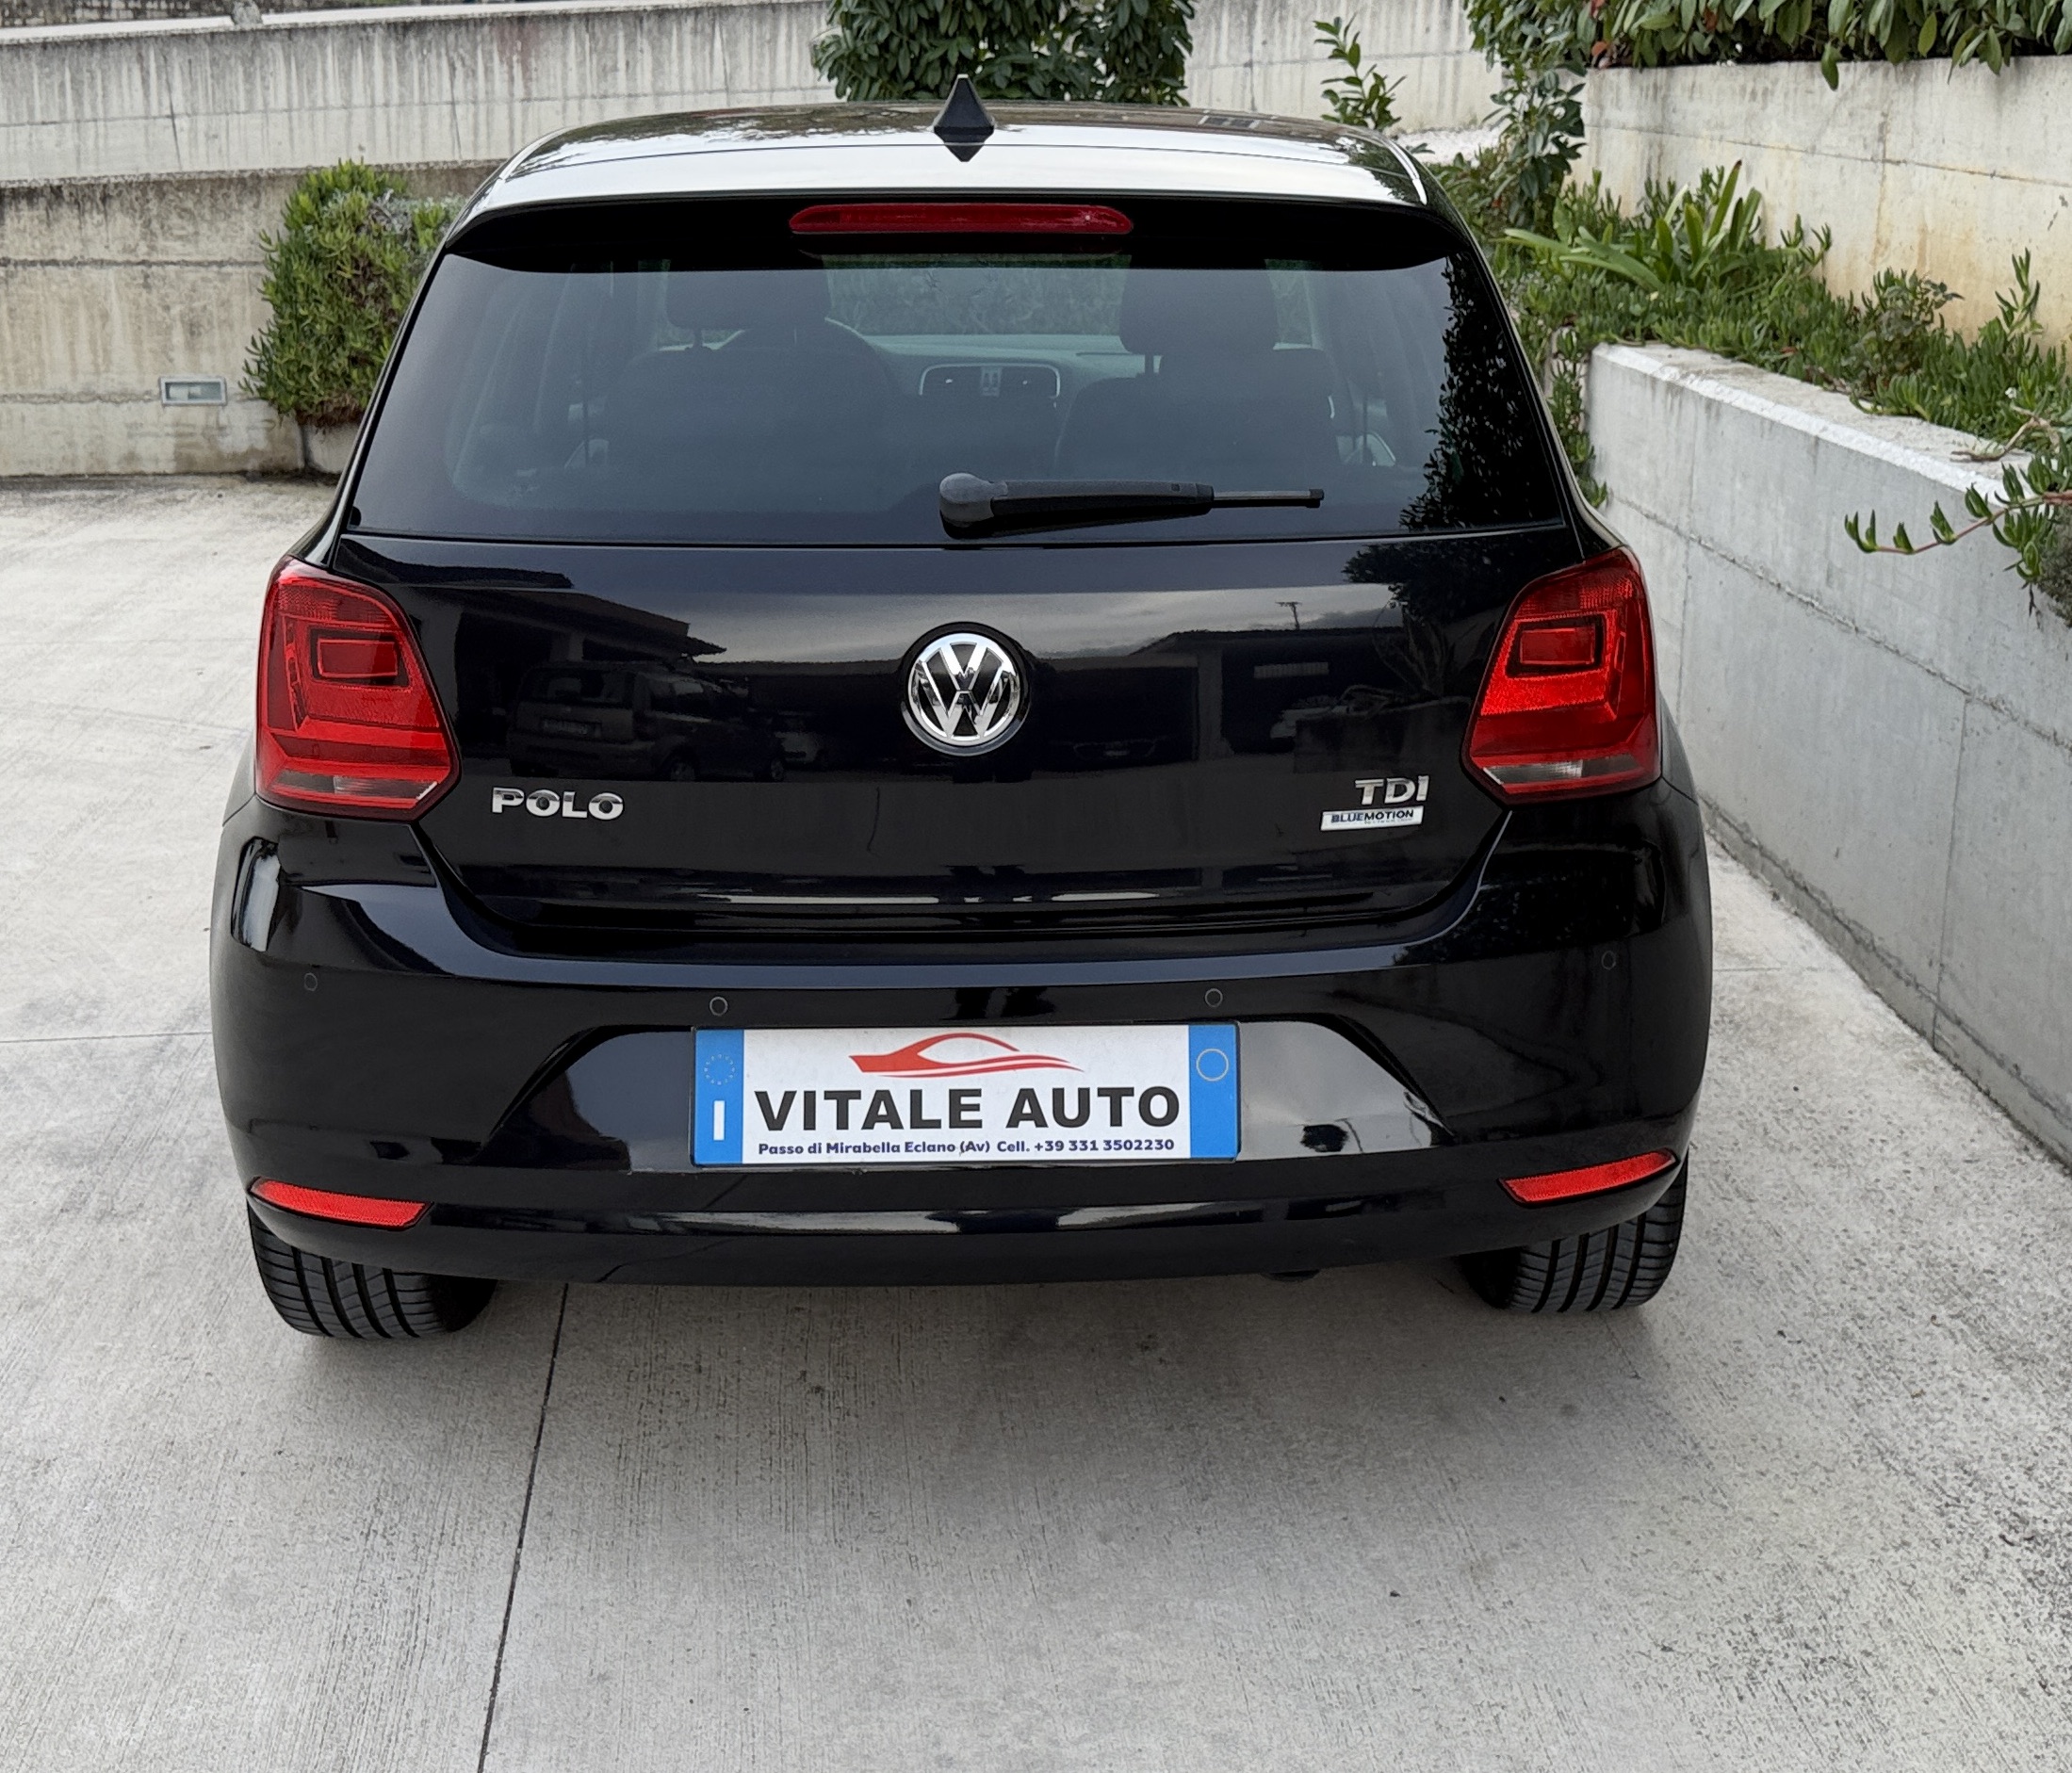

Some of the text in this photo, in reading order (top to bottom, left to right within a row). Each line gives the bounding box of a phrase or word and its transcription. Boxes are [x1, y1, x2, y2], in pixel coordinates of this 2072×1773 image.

[492, 787, 624, 821] POLO
[1355, 775, 1429, 805] TDI
[1330, 809, 1414, 823] BLUEMOTION
[713, 1099, 726, 1141] I
[754, 1085, 1180, 1131] VITALE AUTO
[758, 1138, 1175, 1155] Passo di Mirabella Eclano (Av) Cell. +39 331 3502230
